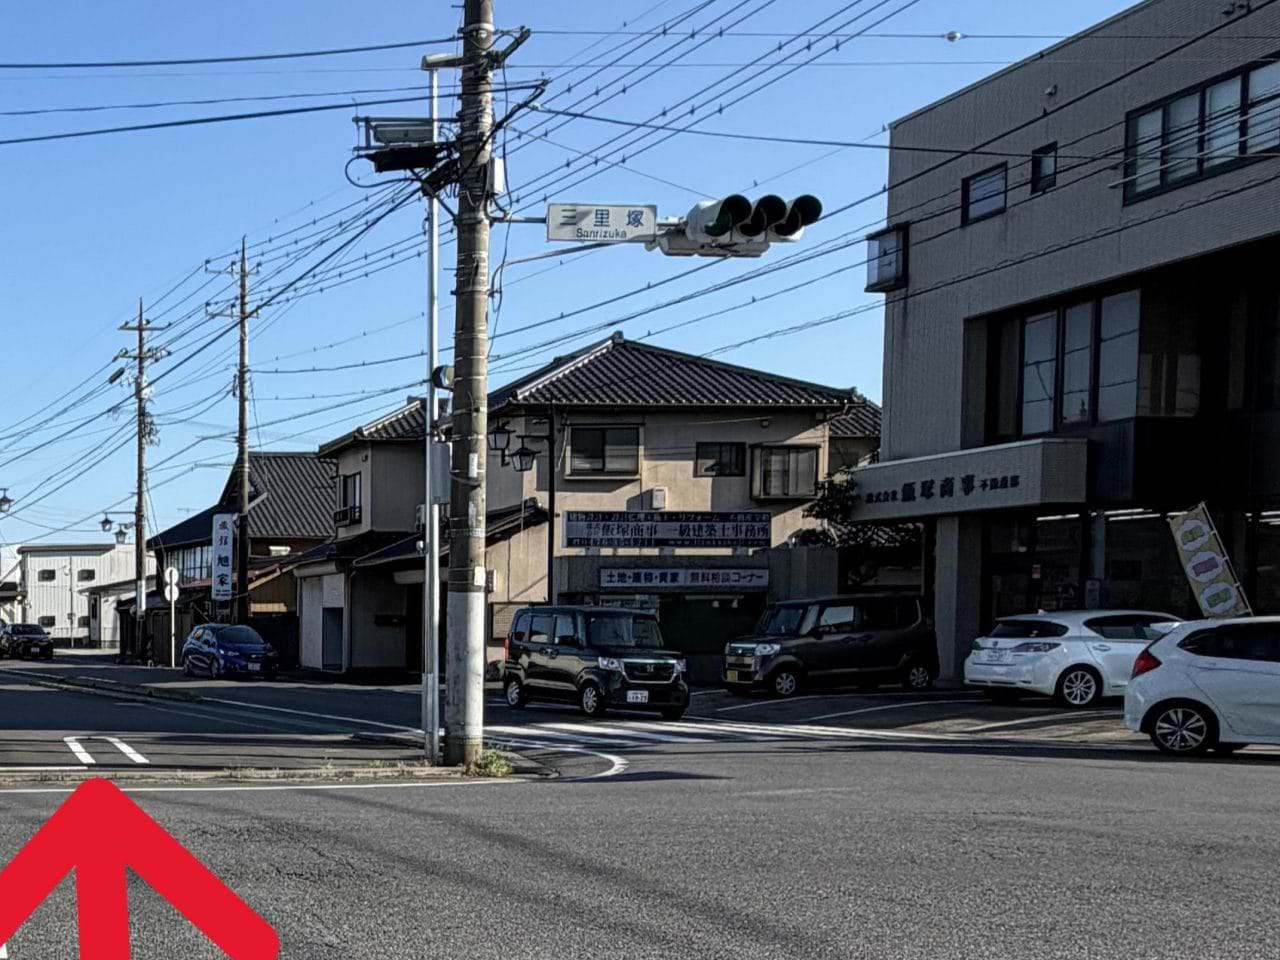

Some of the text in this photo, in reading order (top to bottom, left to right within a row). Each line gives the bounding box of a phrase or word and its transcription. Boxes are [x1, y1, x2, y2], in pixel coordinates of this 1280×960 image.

[559, 208, 644, 228] 三里塚
[576, 228, 627, 239] Sanrizuka
